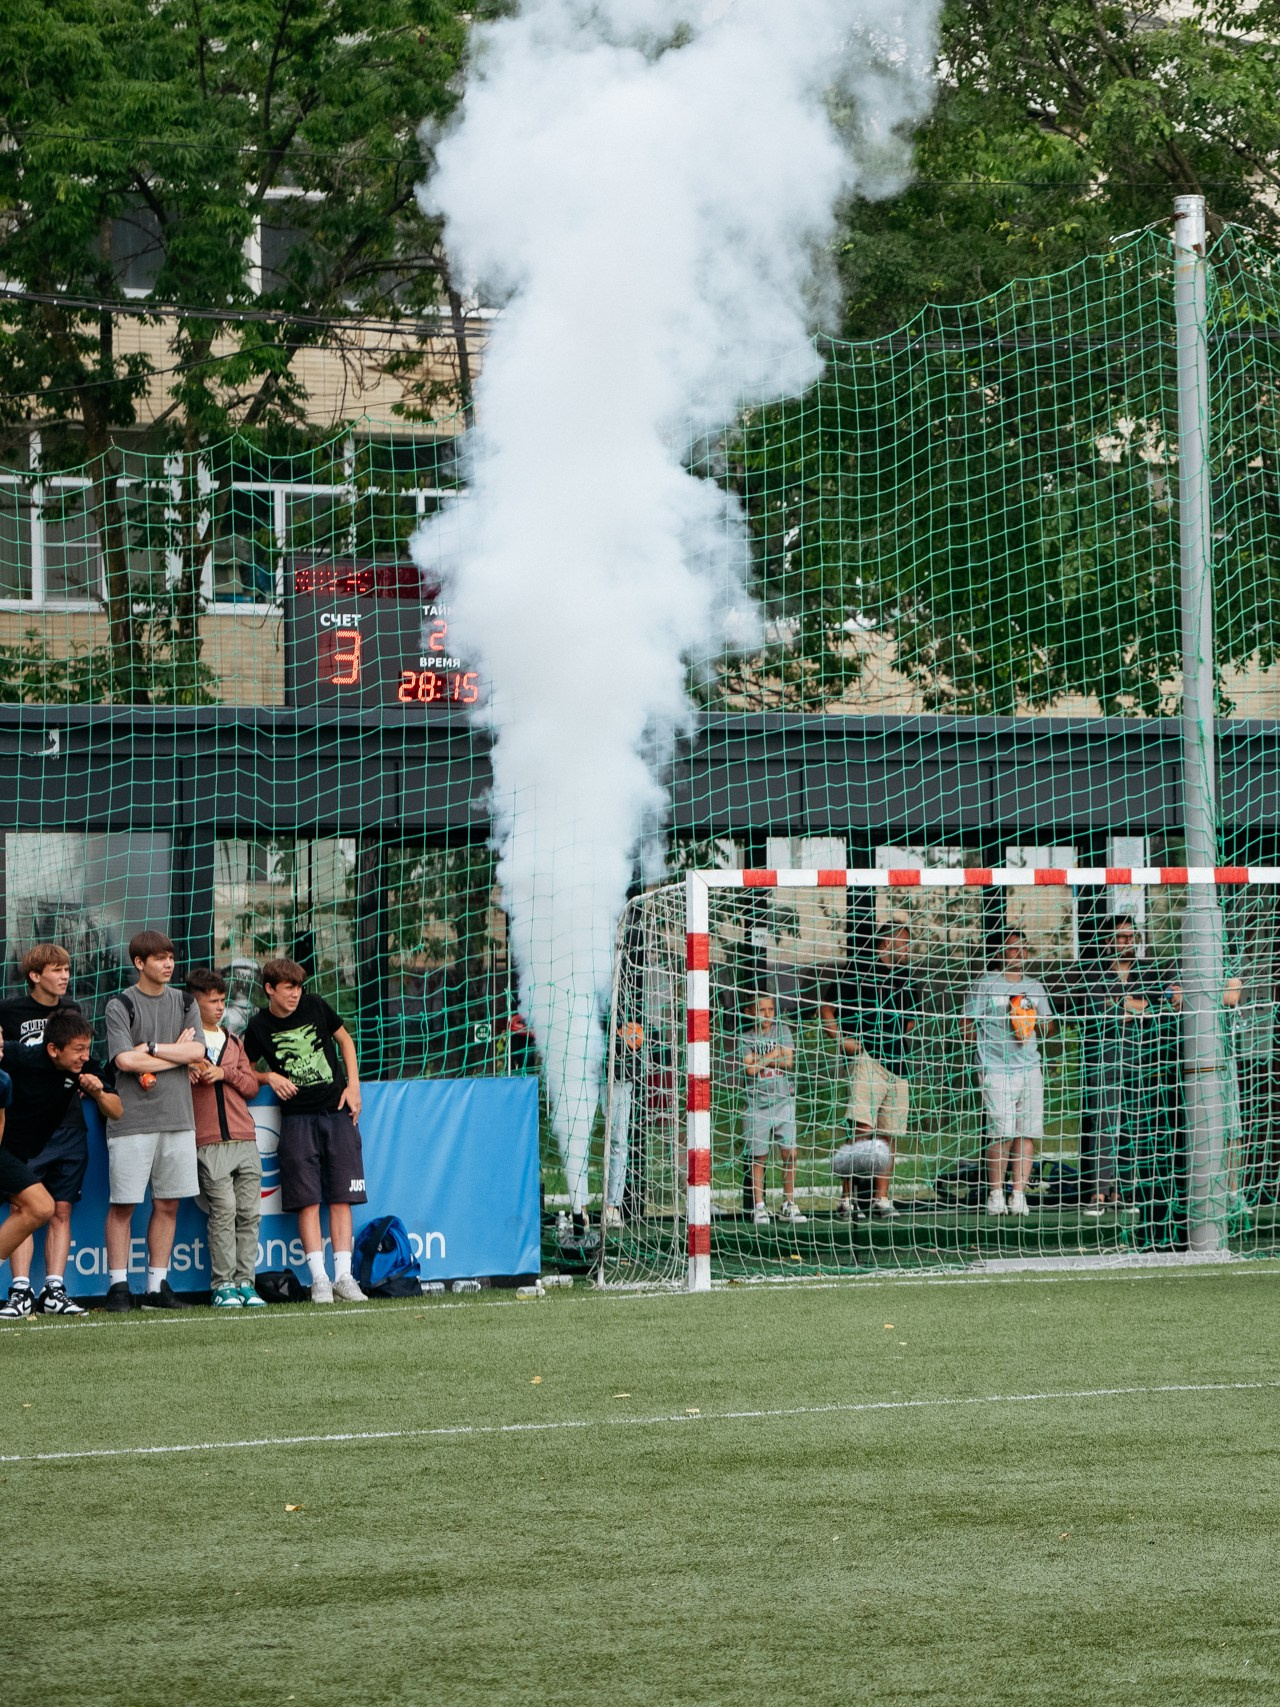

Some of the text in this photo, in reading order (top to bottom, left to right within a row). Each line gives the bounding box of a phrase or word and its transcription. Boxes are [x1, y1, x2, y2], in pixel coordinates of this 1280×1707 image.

[320, 613, 361, 627] СЧЕТ
[430, 619, 448, 651] 2
[332, 630, 361, 685] 3
[419, 657, 461, 668] ВРЕМЯ
[398, 671, 479, 703] 28:15
